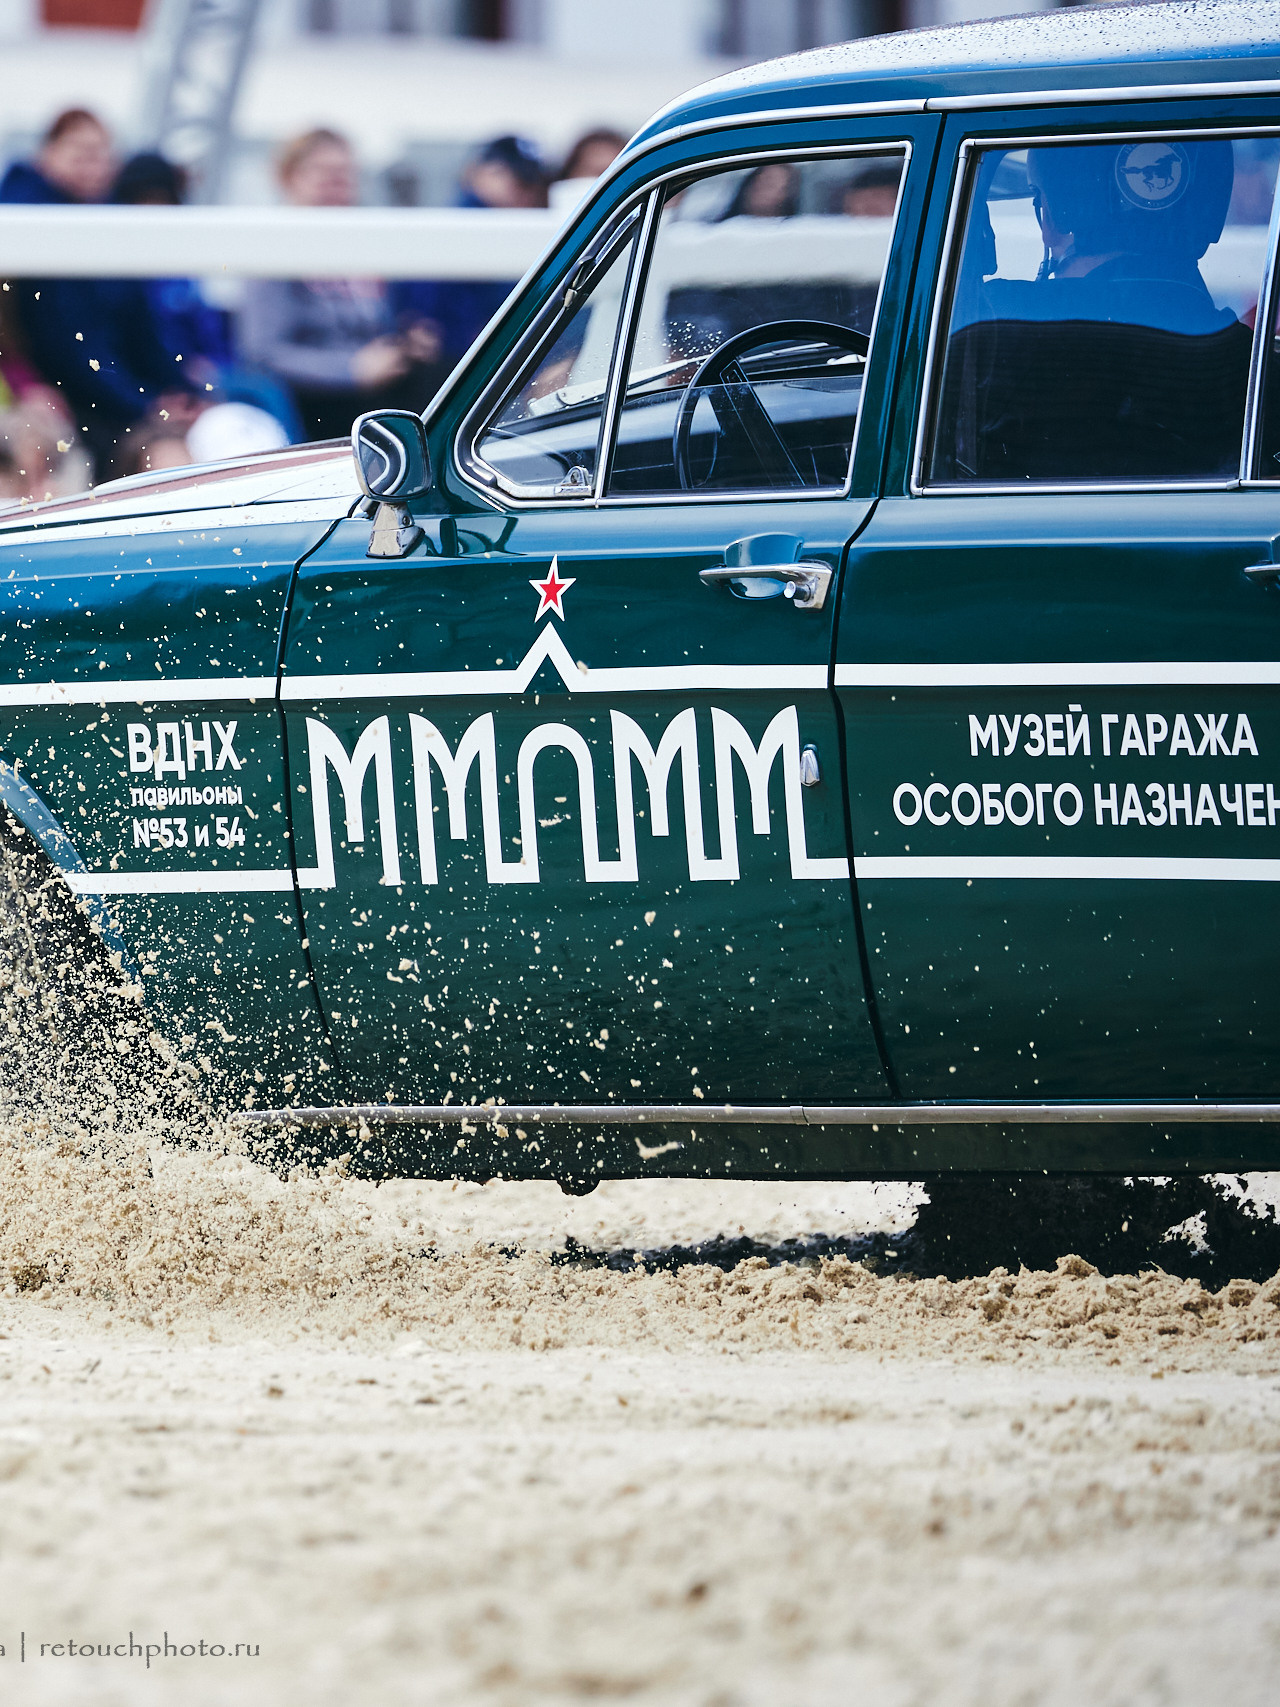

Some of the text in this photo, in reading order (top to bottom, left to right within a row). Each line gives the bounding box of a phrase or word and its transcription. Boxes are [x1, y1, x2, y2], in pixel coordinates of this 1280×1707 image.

[127, 720, 242, 781] ВДНХ
[968, 703, 1259, 757] МУЗЕЙ ГАРАЖА
[131, 786, 243, 806] павильоны
[892, 782, 1084, 826] ОСОБОГО
[132, 816, 246, 849] №53 и 54
